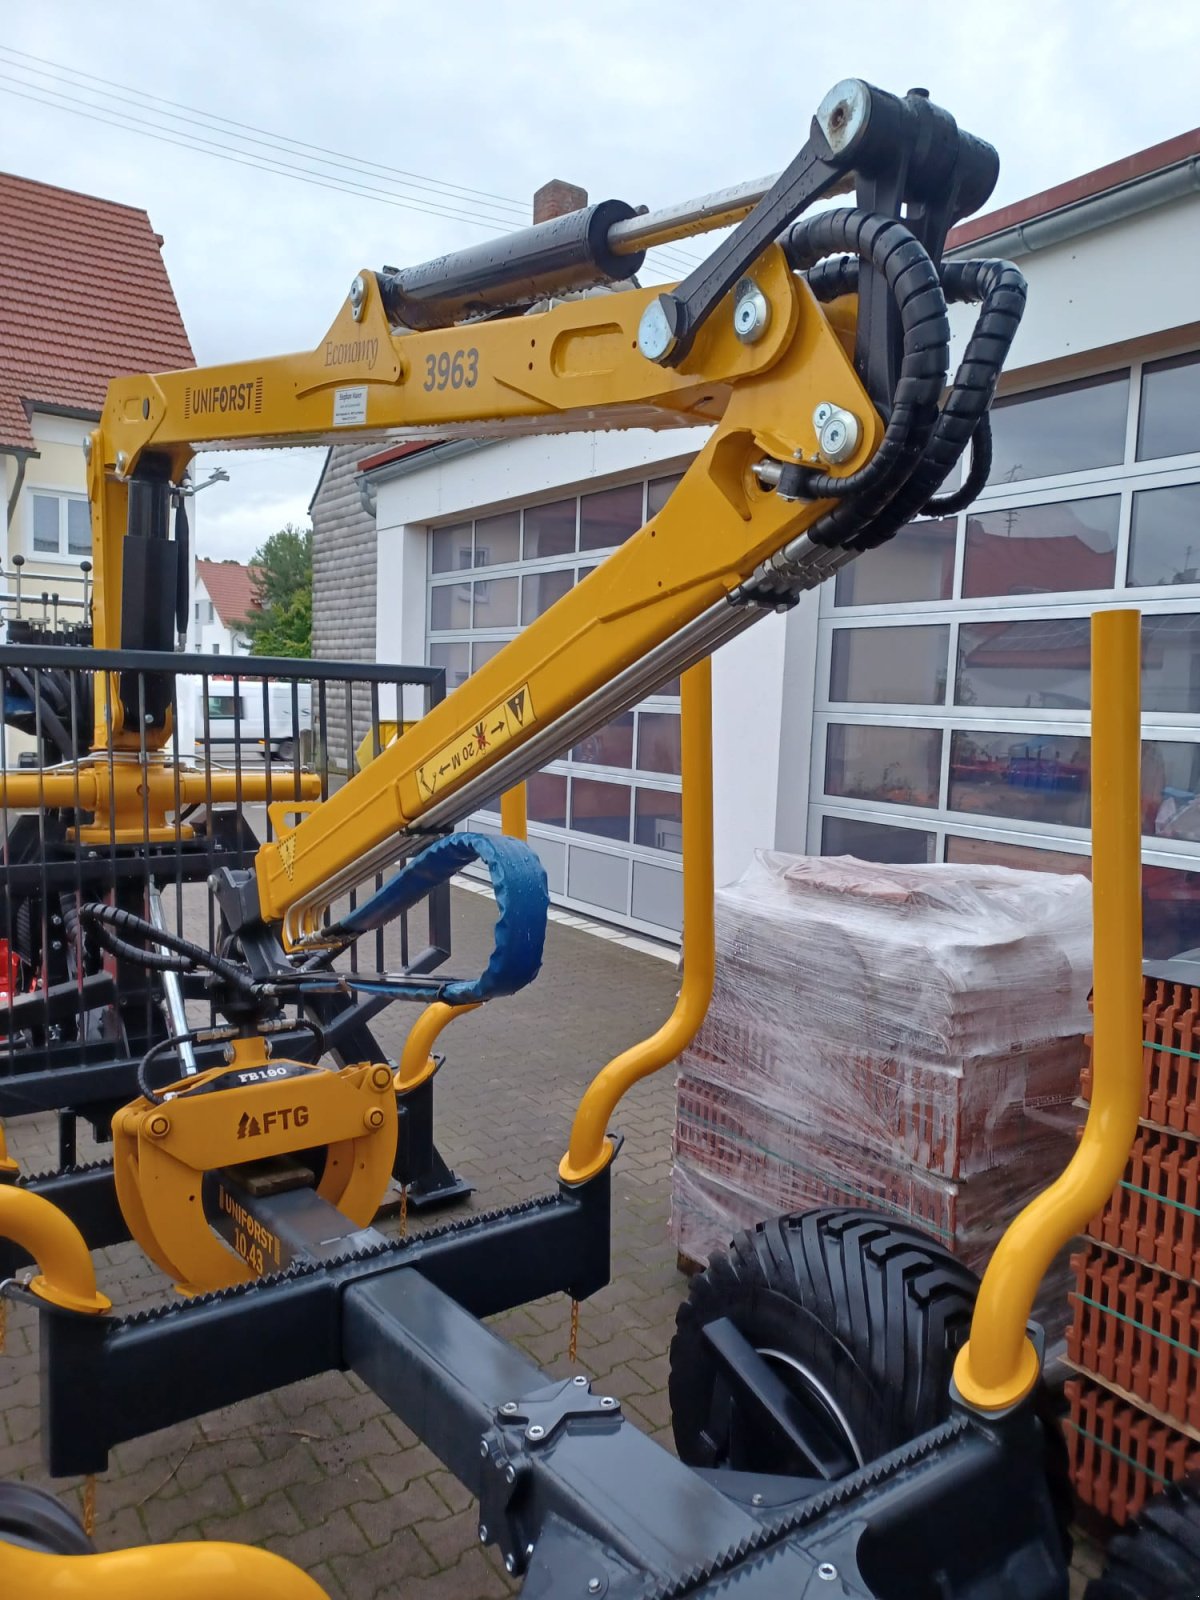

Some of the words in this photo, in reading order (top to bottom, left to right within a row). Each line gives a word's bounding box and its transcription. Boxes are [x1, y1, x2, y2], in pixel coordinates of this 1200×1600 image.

[324, 336, 379, 370] Economy
[423, 347, 479, 392] 3963
[193, 382, 254, 415] UNIFORST
[462, 742, 475, 761] 20
[238, 1067, 287, 1083] FB190
[263, 1105, 309, 1134] FTG
[225, 1193, 274, 1254] UNIFORST
[234, 1227, 263, 1275] 10.43
